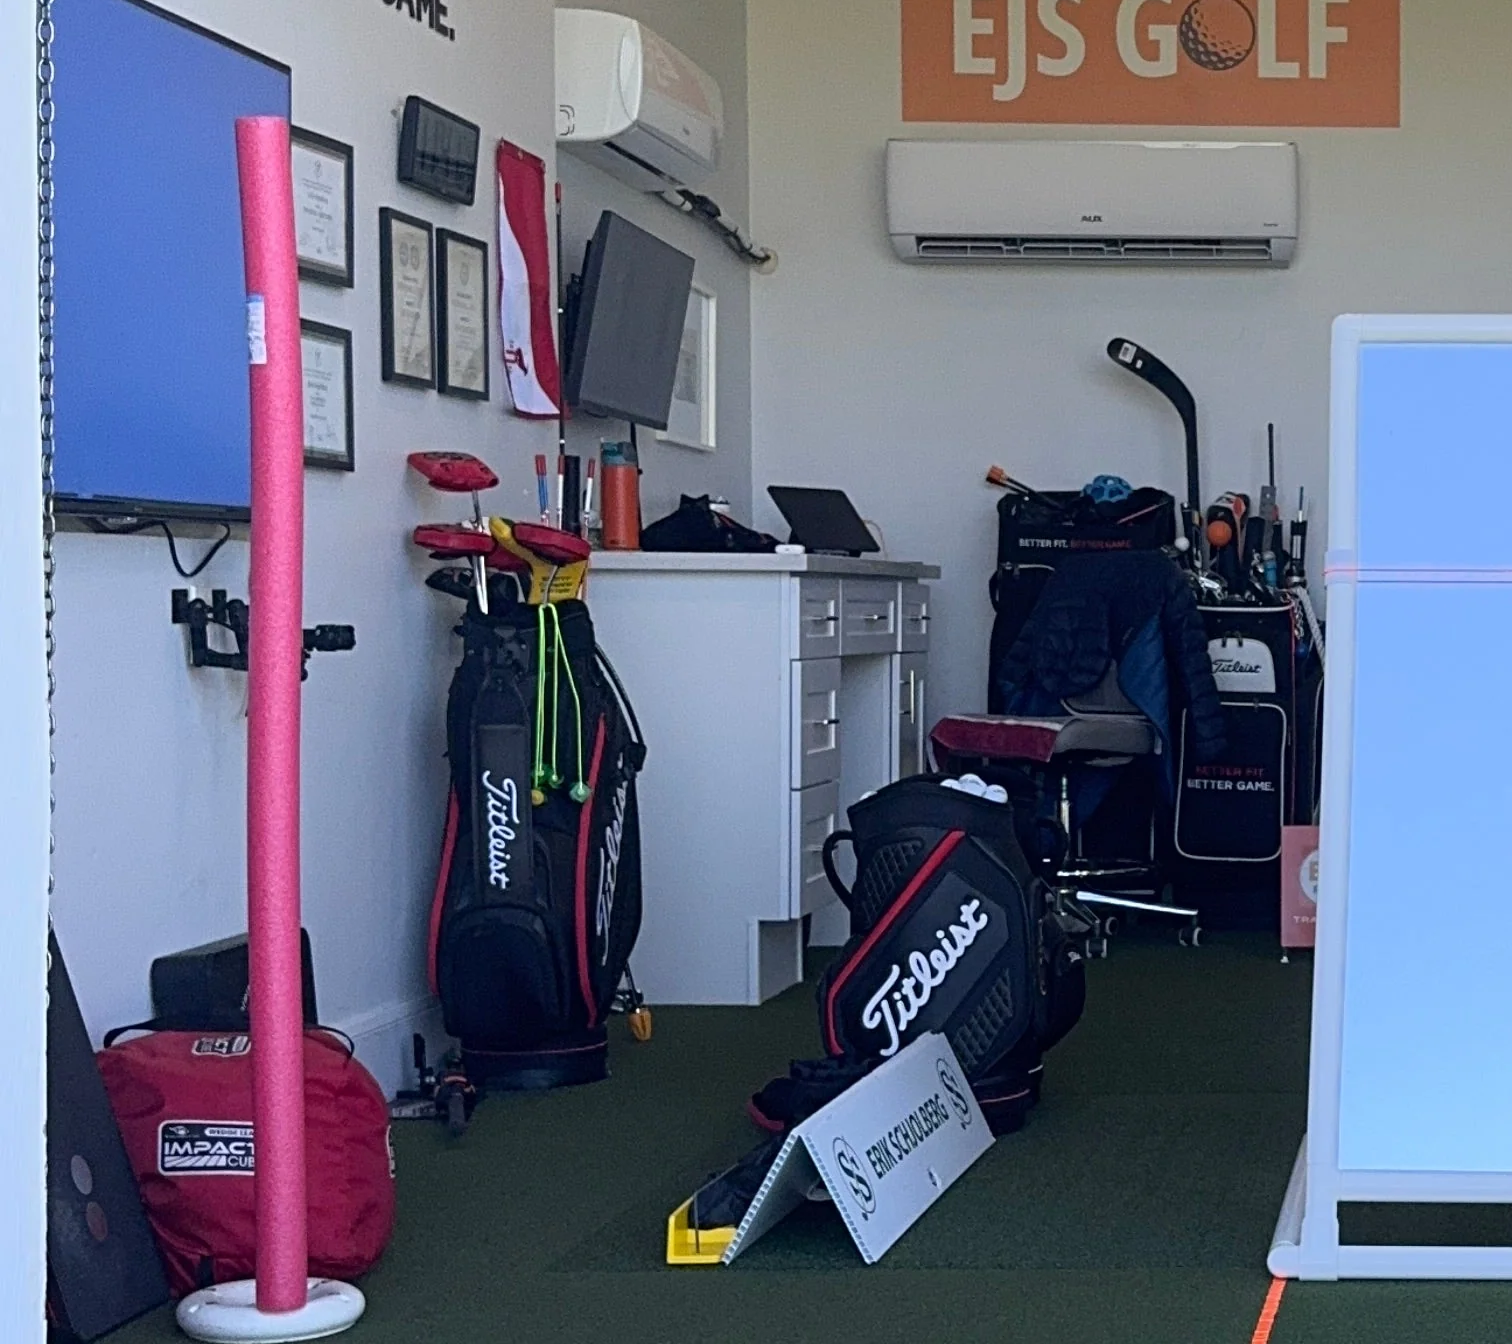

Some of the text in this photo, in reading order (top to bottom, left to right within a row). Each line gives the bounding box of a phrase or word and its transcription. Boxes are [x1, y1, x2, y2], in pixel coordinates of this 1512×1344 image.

[1211, 658, 1262, 674] Titleist
[1187, 778, 1275, 792] BETTER GAME.
[482, 770, 520, 890] Titleist
[862, 898, 988, 1056] Titleist
[865, 1147, 898, 1179] ERIK
[887, 1093, 949, 1161] SCHJOLBERG
